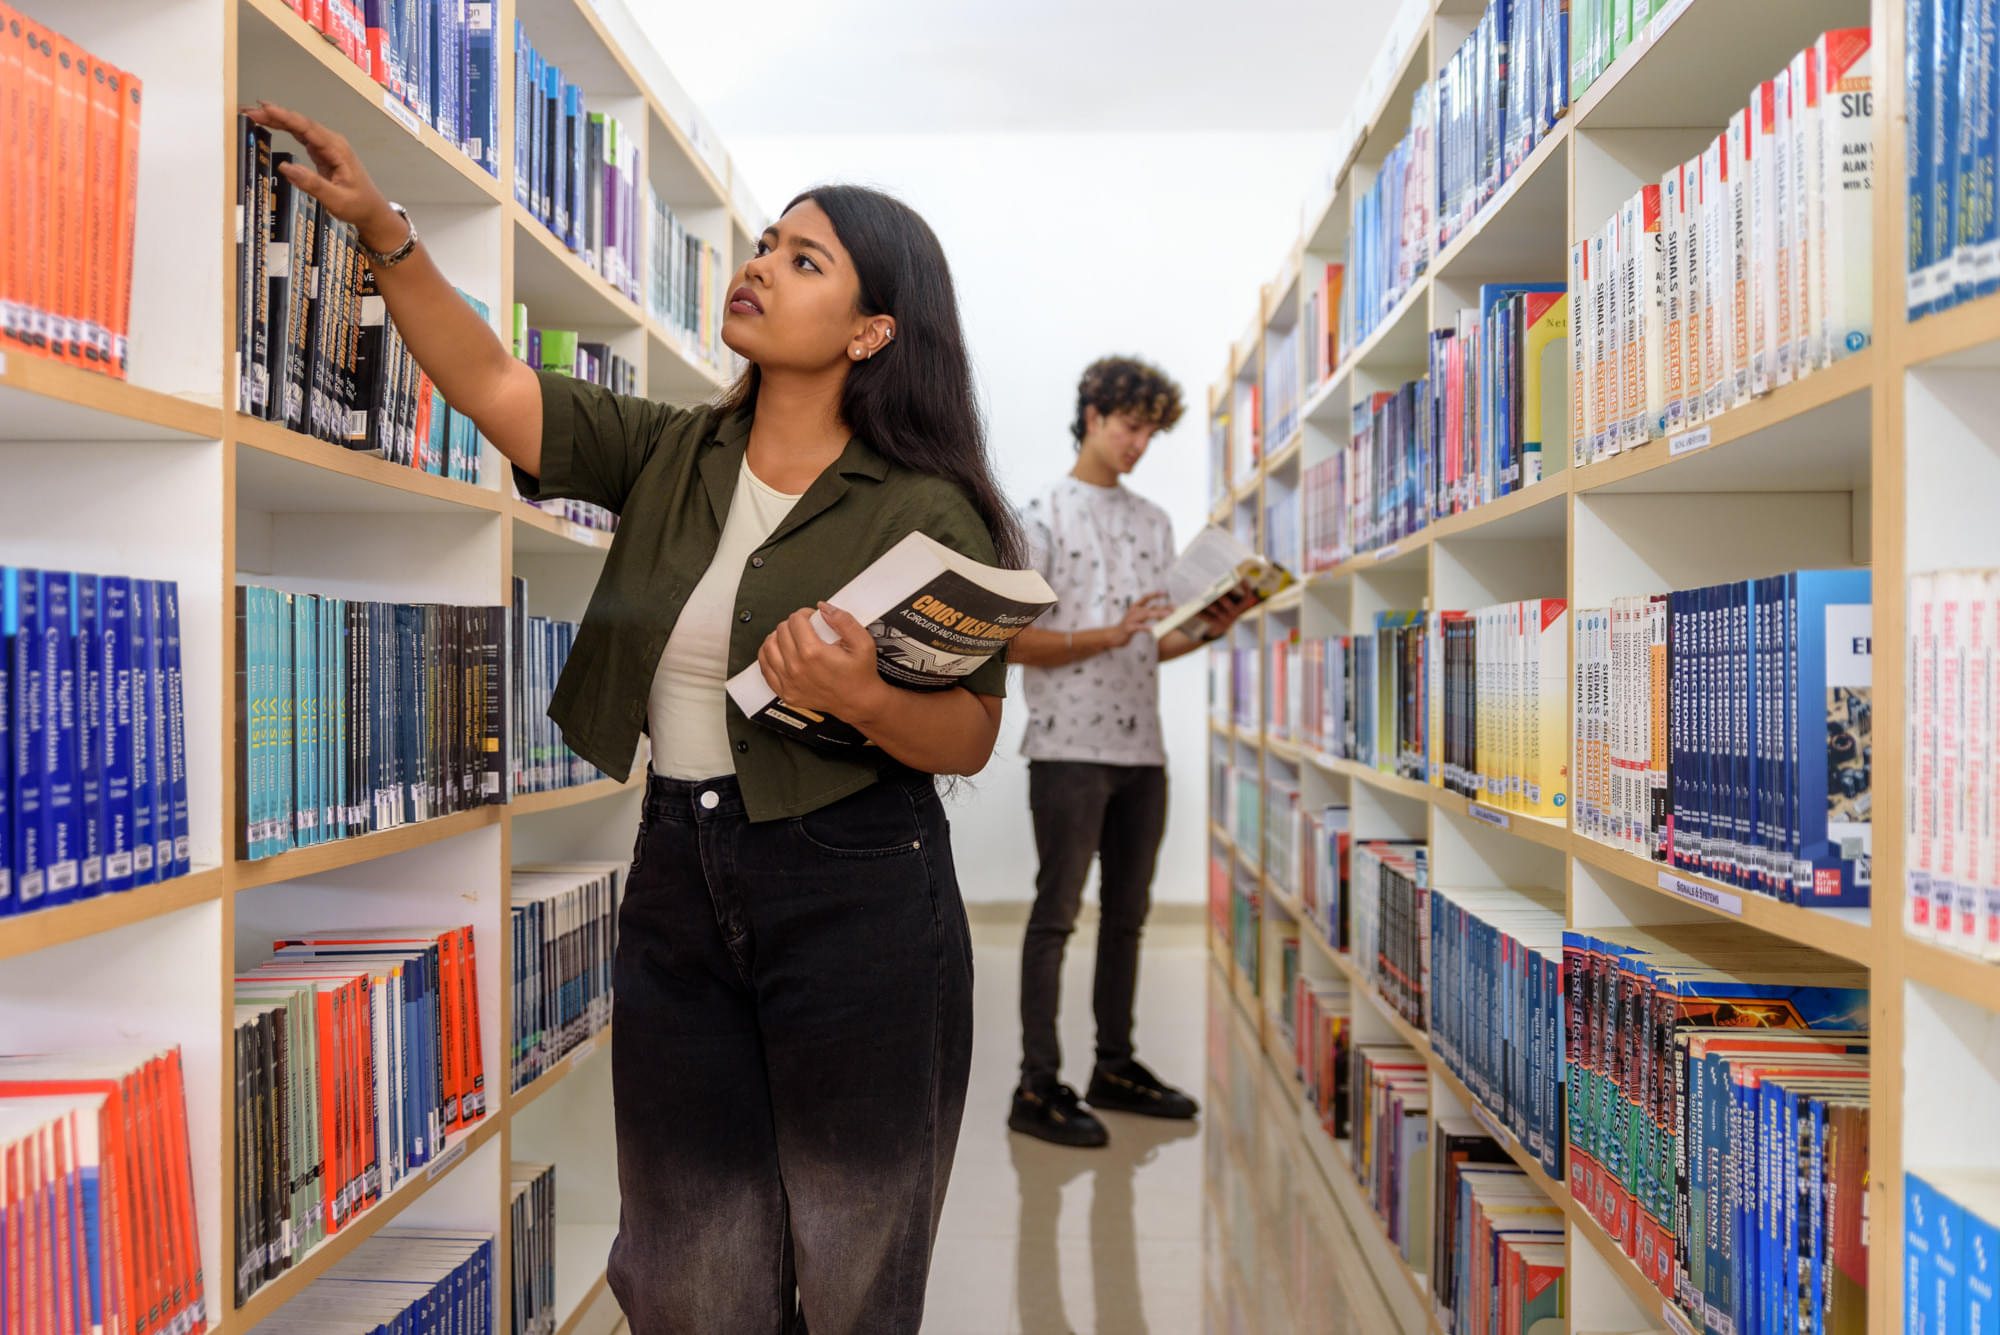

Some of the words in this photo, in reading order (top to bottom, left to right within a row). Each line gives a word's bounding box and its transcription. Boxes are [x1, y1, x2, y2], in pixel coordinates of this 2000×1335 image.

[1668, 231, 1679, 292] SIGNALS
[1688, 223, 1698, 286] SIGNALS
[1597, 282, 1605, 336] SIGNALS
[1627, 257, 1636, 315] SIGNALS
[1574, 295, 1583, 346] SIGNALS
[906, 611, 941, 633] CIRCUITS
[937, 627, 953, 639] AND
[911, 594, 964, 627] CMOS
[954, 615, 988, 637] VLSI
[117, 670, 130, 725] Digital
[252, 698, 260, 749] VLSI
[269, 697, 277, 746] VLSI
[1816, 871, 1830, 879] Mc
[1816, 879, 1839, 887] Graw
[1572, 956, 1583, 1003] Basic
[1664, 1003, 1675, 1056] Basic
[1572, 1009, 1583, 1107] Electronics
[1675, 1050, 1685, 1092] Basic
[1661, 1064, 1673, 1180] Electronics
[1676, 1094, 1686, 1177] Electronics
[1711, 1147, 1719, 1250] ELECTRONICS
